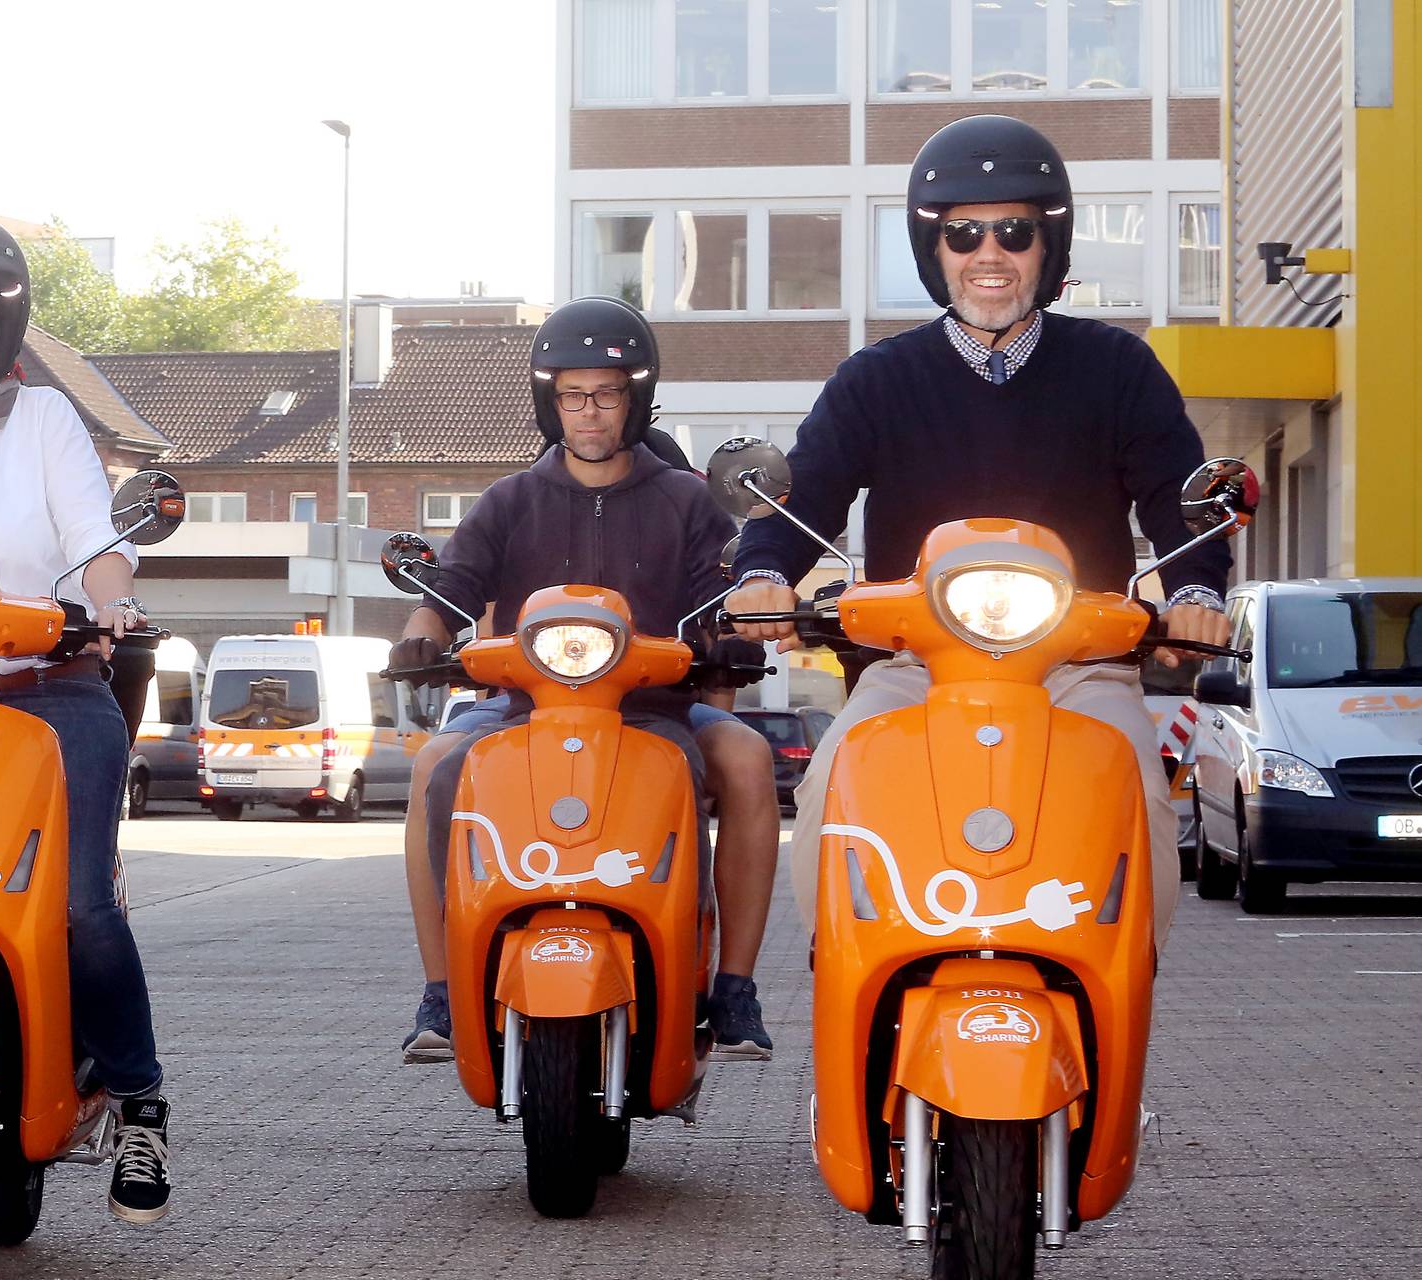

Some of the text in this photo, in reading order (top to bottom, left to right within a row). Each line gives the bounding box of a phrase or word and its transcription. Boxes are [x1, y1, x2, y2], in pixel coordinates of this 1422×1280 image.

[541, 955, 584, 963] SHARING
[961, 989, 1024, 1000] 18011
[973, 1034, 1031, 1043] SHARING
